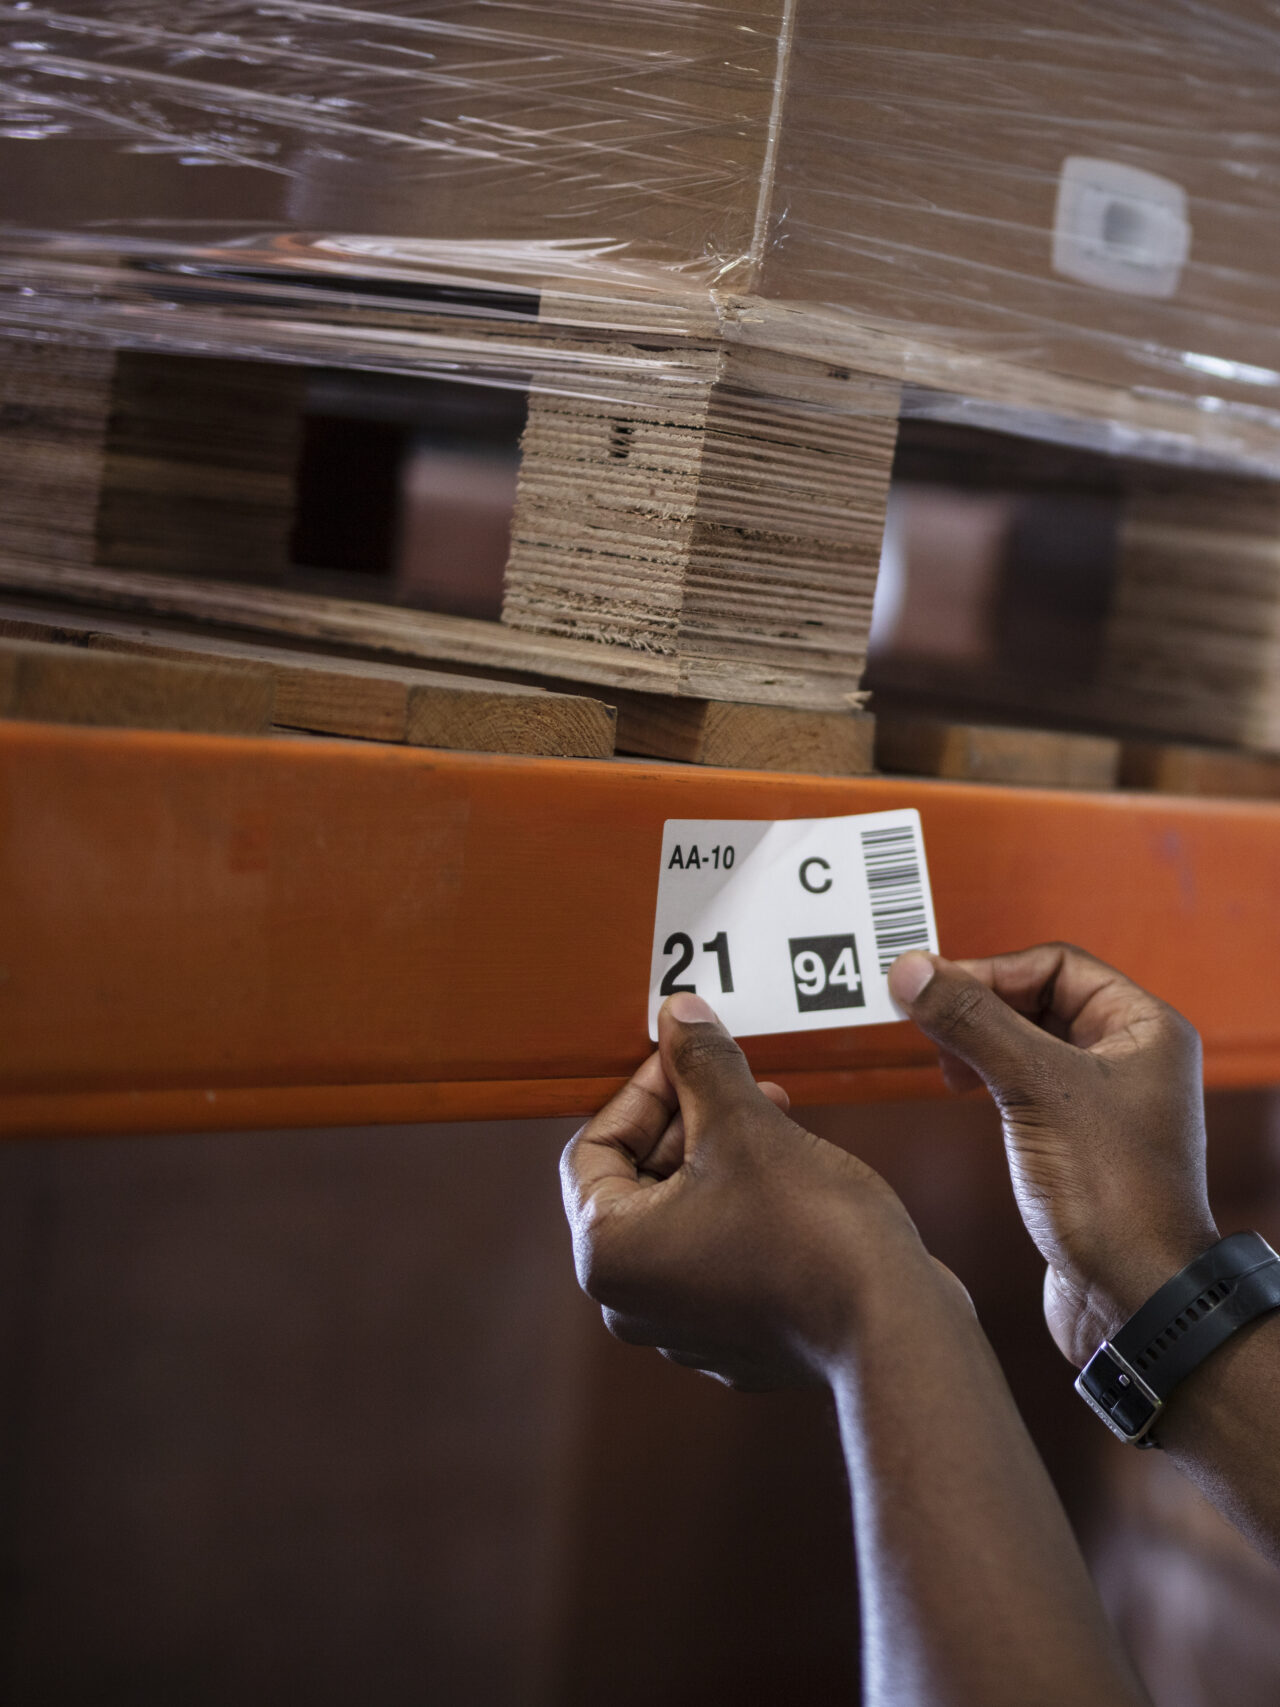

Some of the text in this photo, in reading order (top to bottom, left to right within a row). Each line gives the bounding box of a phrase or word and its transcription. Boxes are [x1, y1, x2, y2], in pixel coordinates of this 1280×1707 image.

[668, 845, 735, 869] AA-10
[799, 856, 833, 894] C
[660, 931, 734, 996] 21
[793, 947, 861, 996] 94
